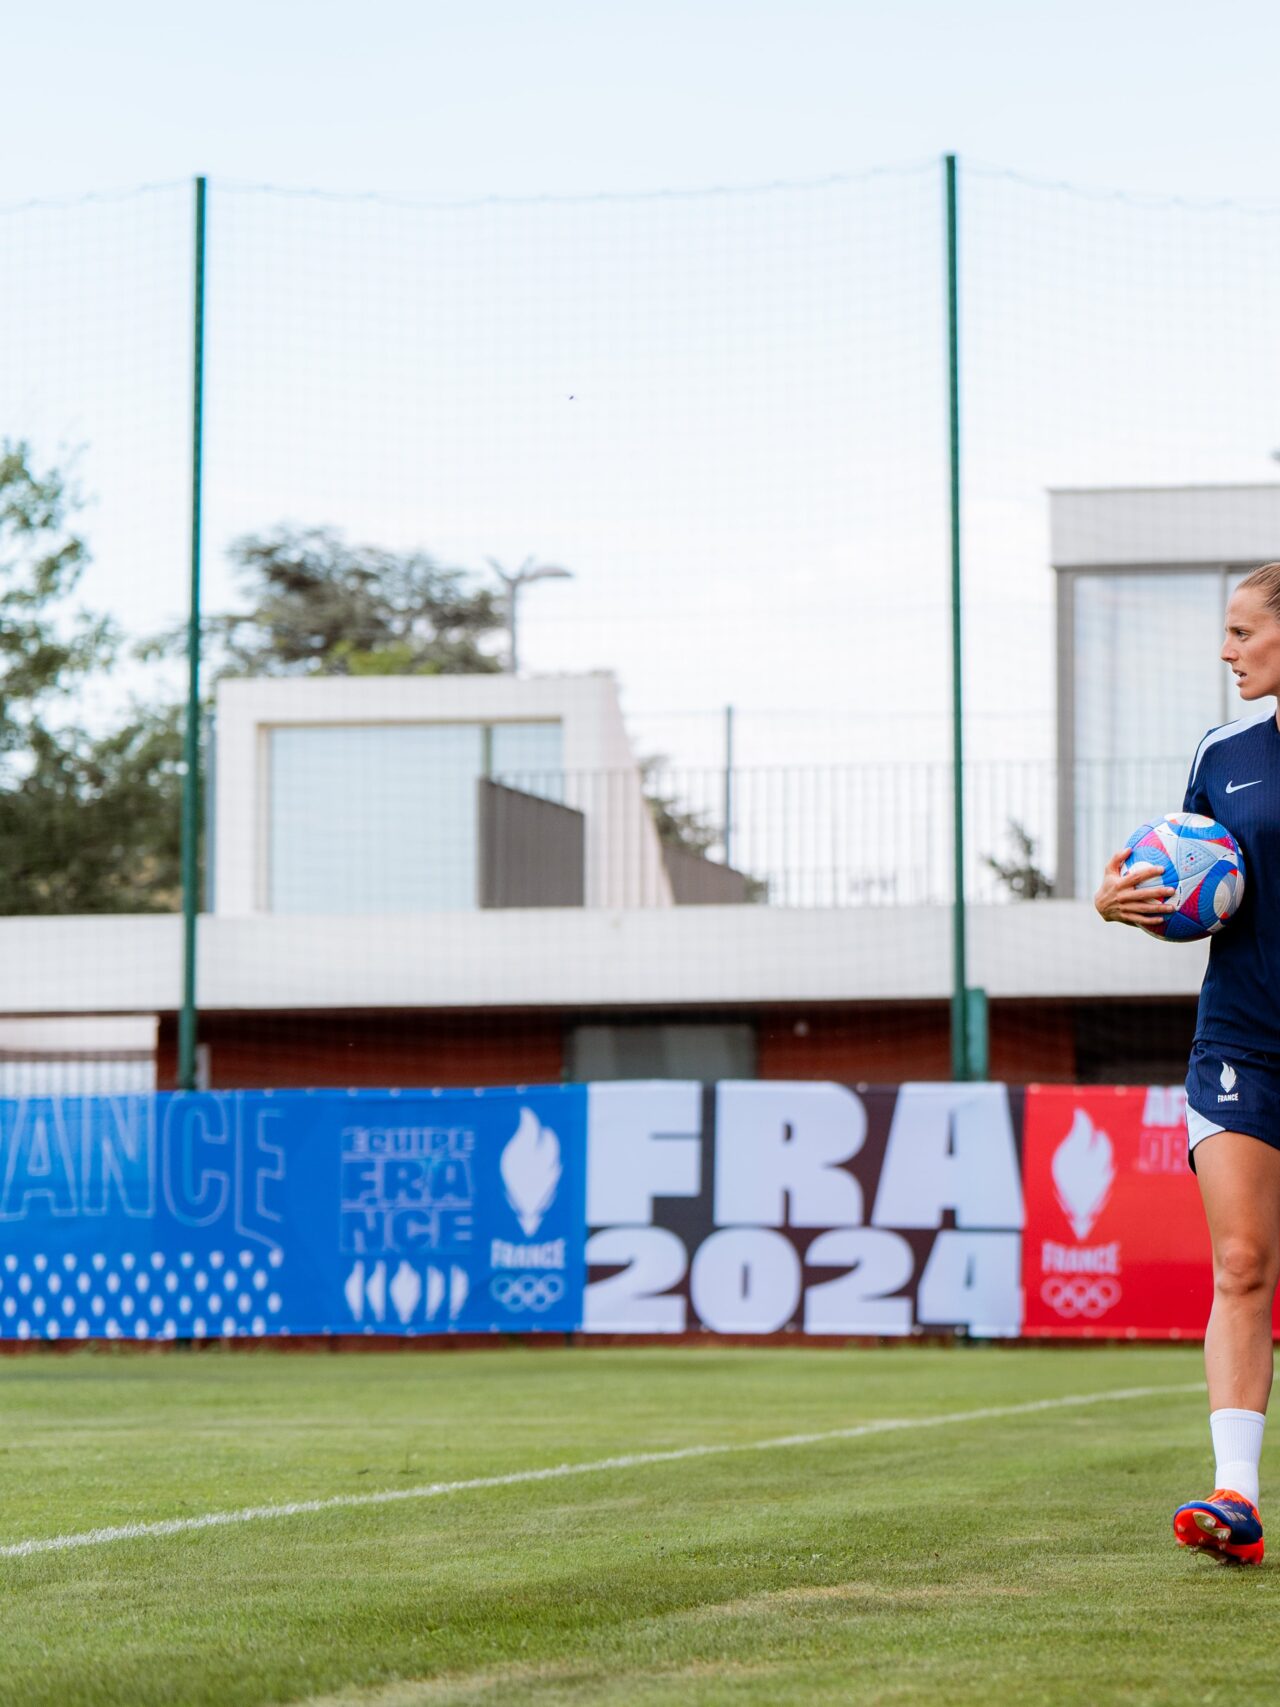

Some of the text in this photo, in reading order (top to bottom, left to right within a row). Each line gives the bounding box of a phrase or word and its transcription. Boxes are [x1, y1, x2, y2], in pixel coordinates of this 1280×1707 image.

[1217, 1093, 1239, 1103] FRANCE
[586, 1080, 1026, 1228] FRA
[491, 1239, 565, 1269] FRANCE
[1042, 1241, 1118, 1273] FRANCE
[584, 1226, 1023, 1337] 2024
